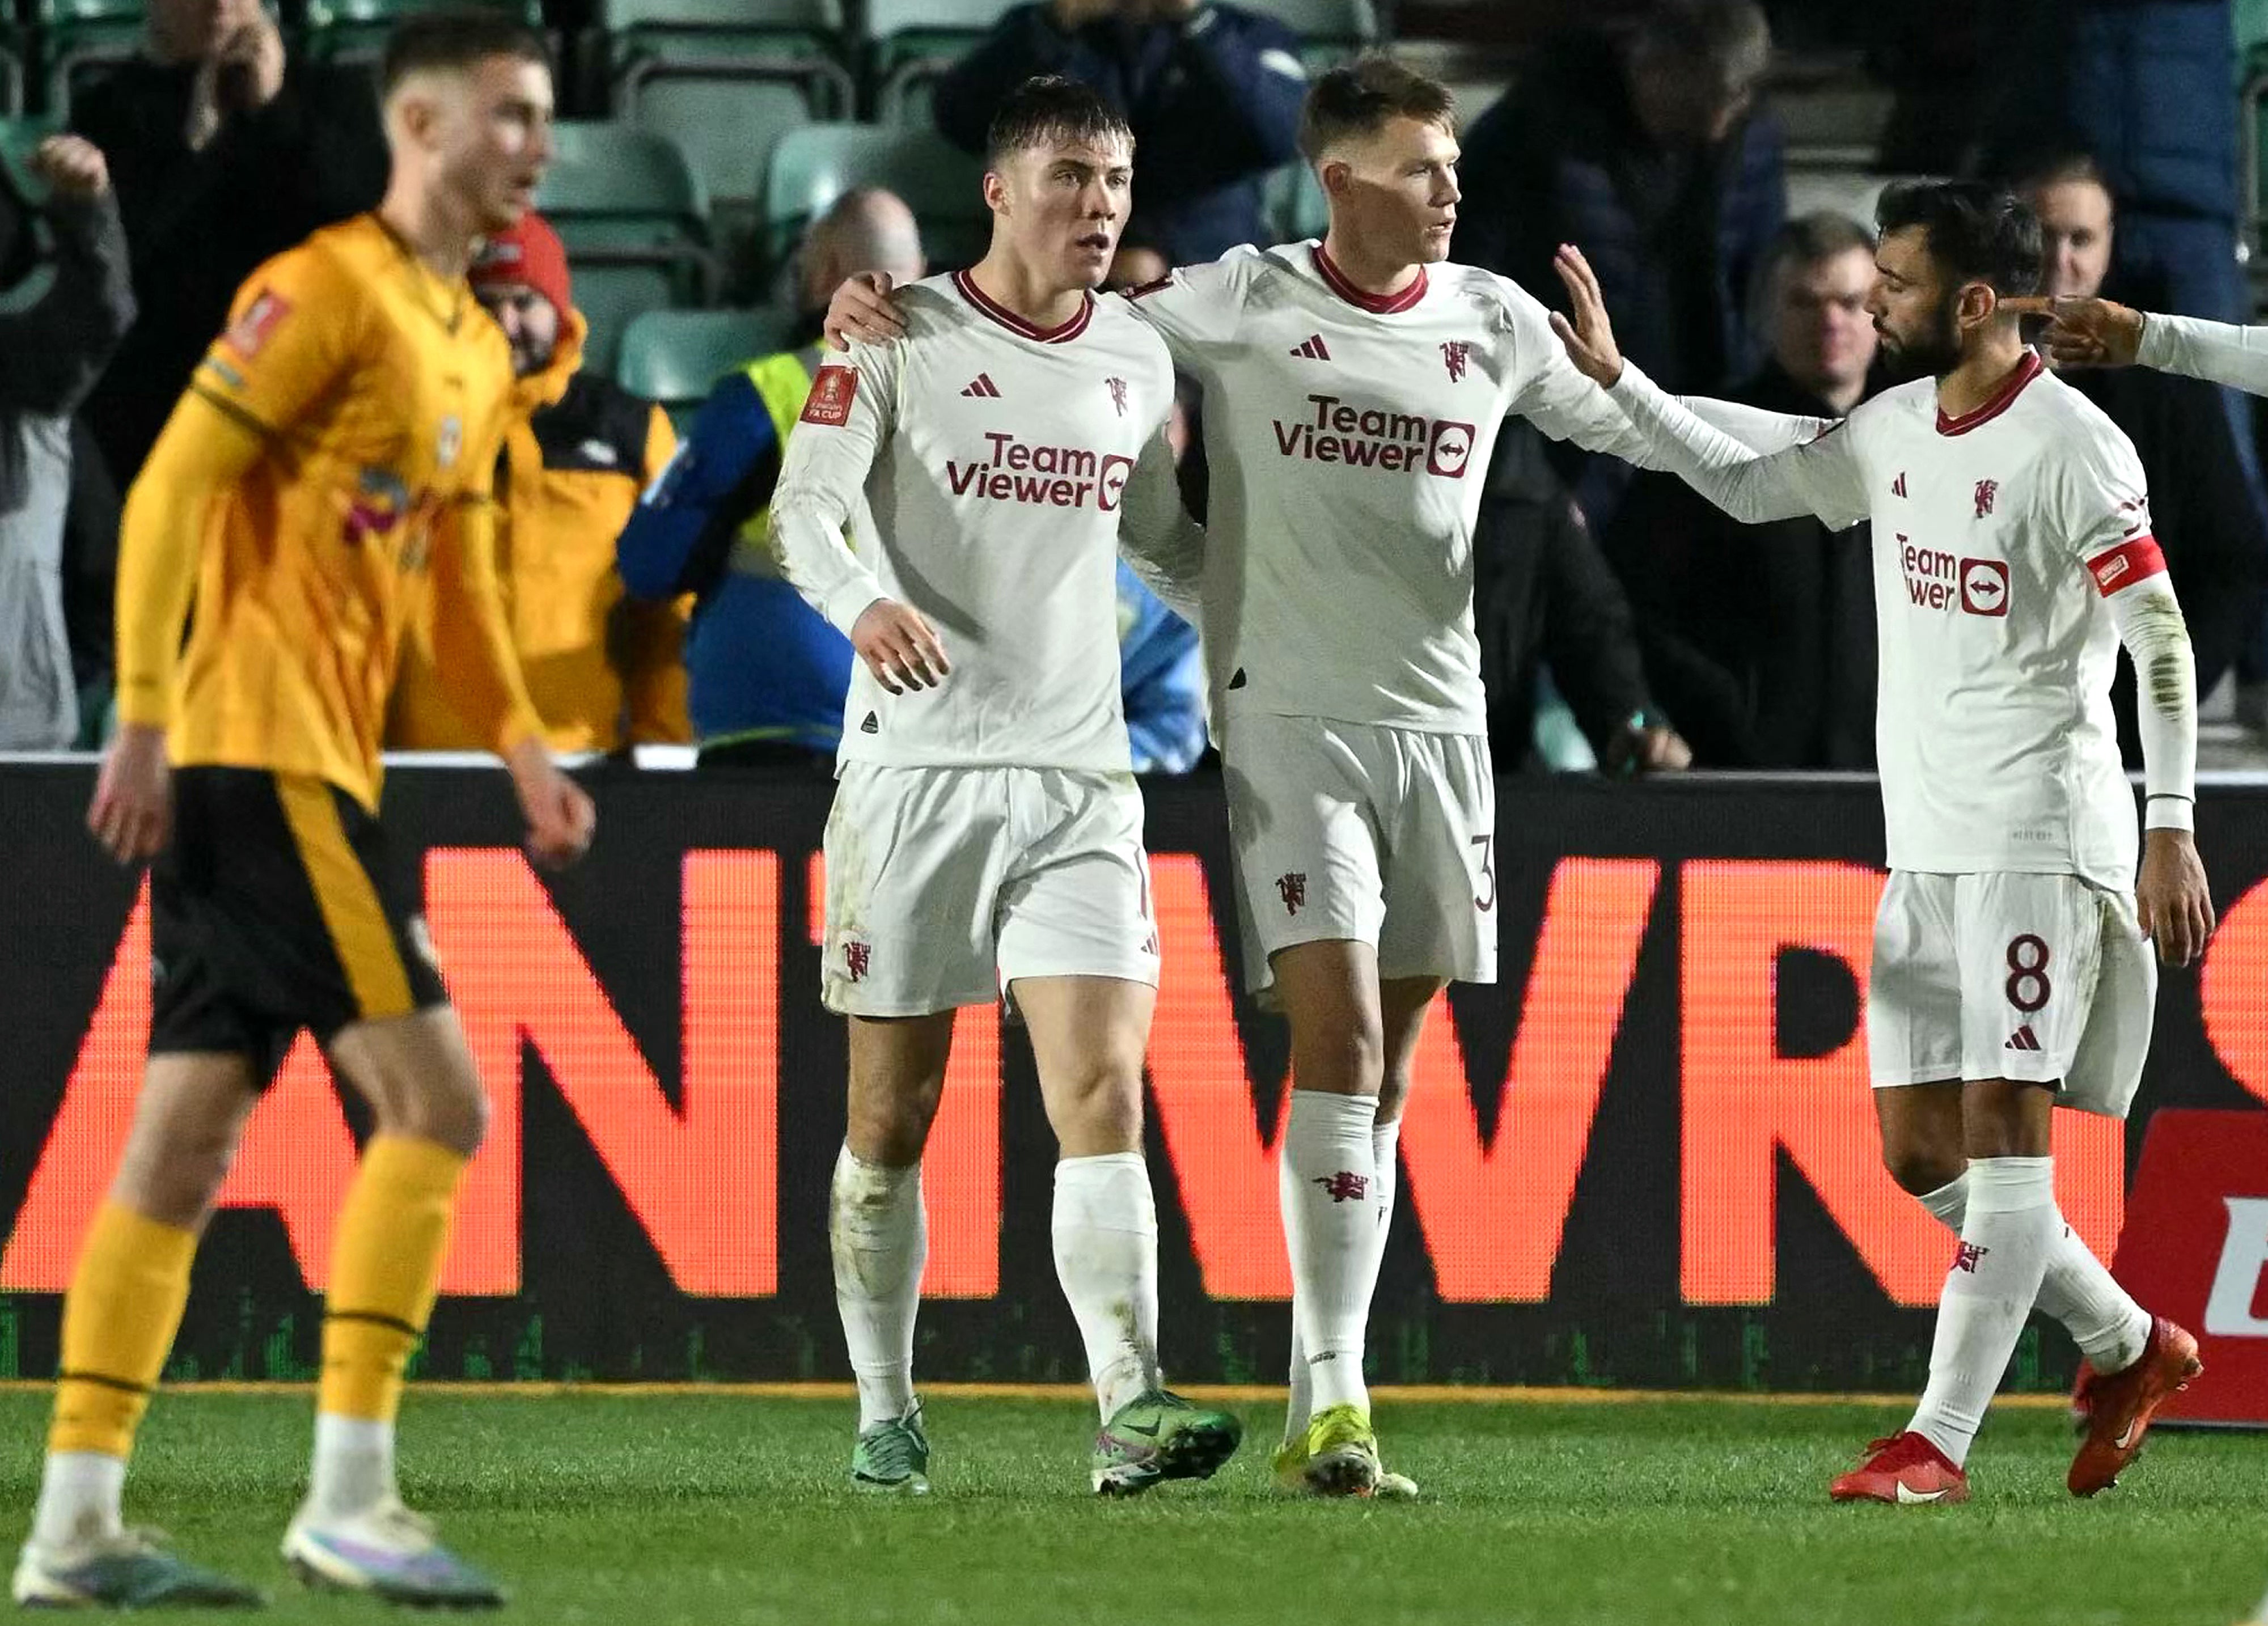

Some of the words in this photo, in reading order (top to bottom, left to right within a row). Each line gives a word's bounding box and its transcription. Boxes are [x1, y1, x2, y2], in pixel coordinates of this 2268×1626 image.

[822, 410, 842, 419] CUP
[1308, 394, 1427, 442] Team
[985, 432, 1095, 477] Team
[1273, 420, 1424, 472] Viewer
[946, 460, 1093, 507] Viewer
[1906, 576, 1955, 611] wer
[2005, 934, 2051, 1012] 8
